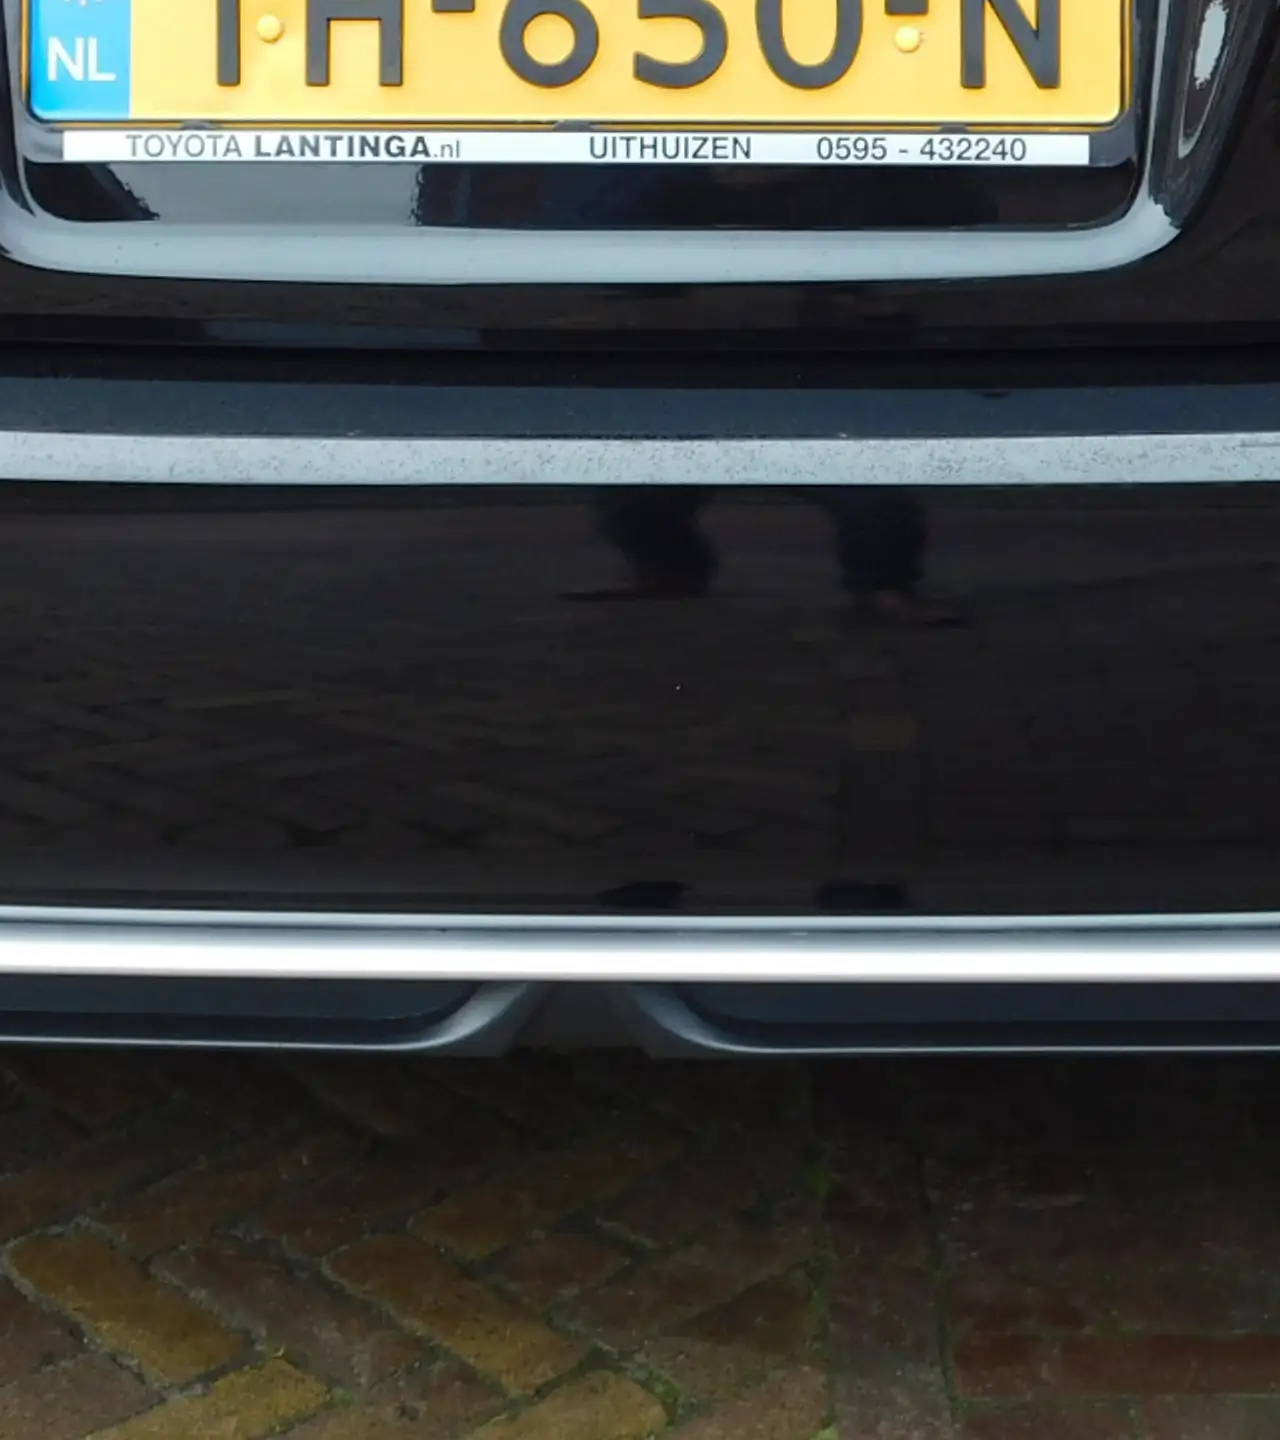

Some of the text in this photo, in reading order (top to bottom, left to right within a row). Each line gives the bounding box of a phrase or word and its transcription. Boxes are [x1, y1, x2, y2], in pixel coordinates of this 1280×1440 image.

[48, 36, 117, 81] NL
[125, 134, 243, 158] TOYOTA
[253, 135, 461, 159] LANTINGA.nl
[589, 136, 752, 160] UITHUIZEN
[816, 136, 888, 161] 0595
[919, 136, 1026, 161] 432240
